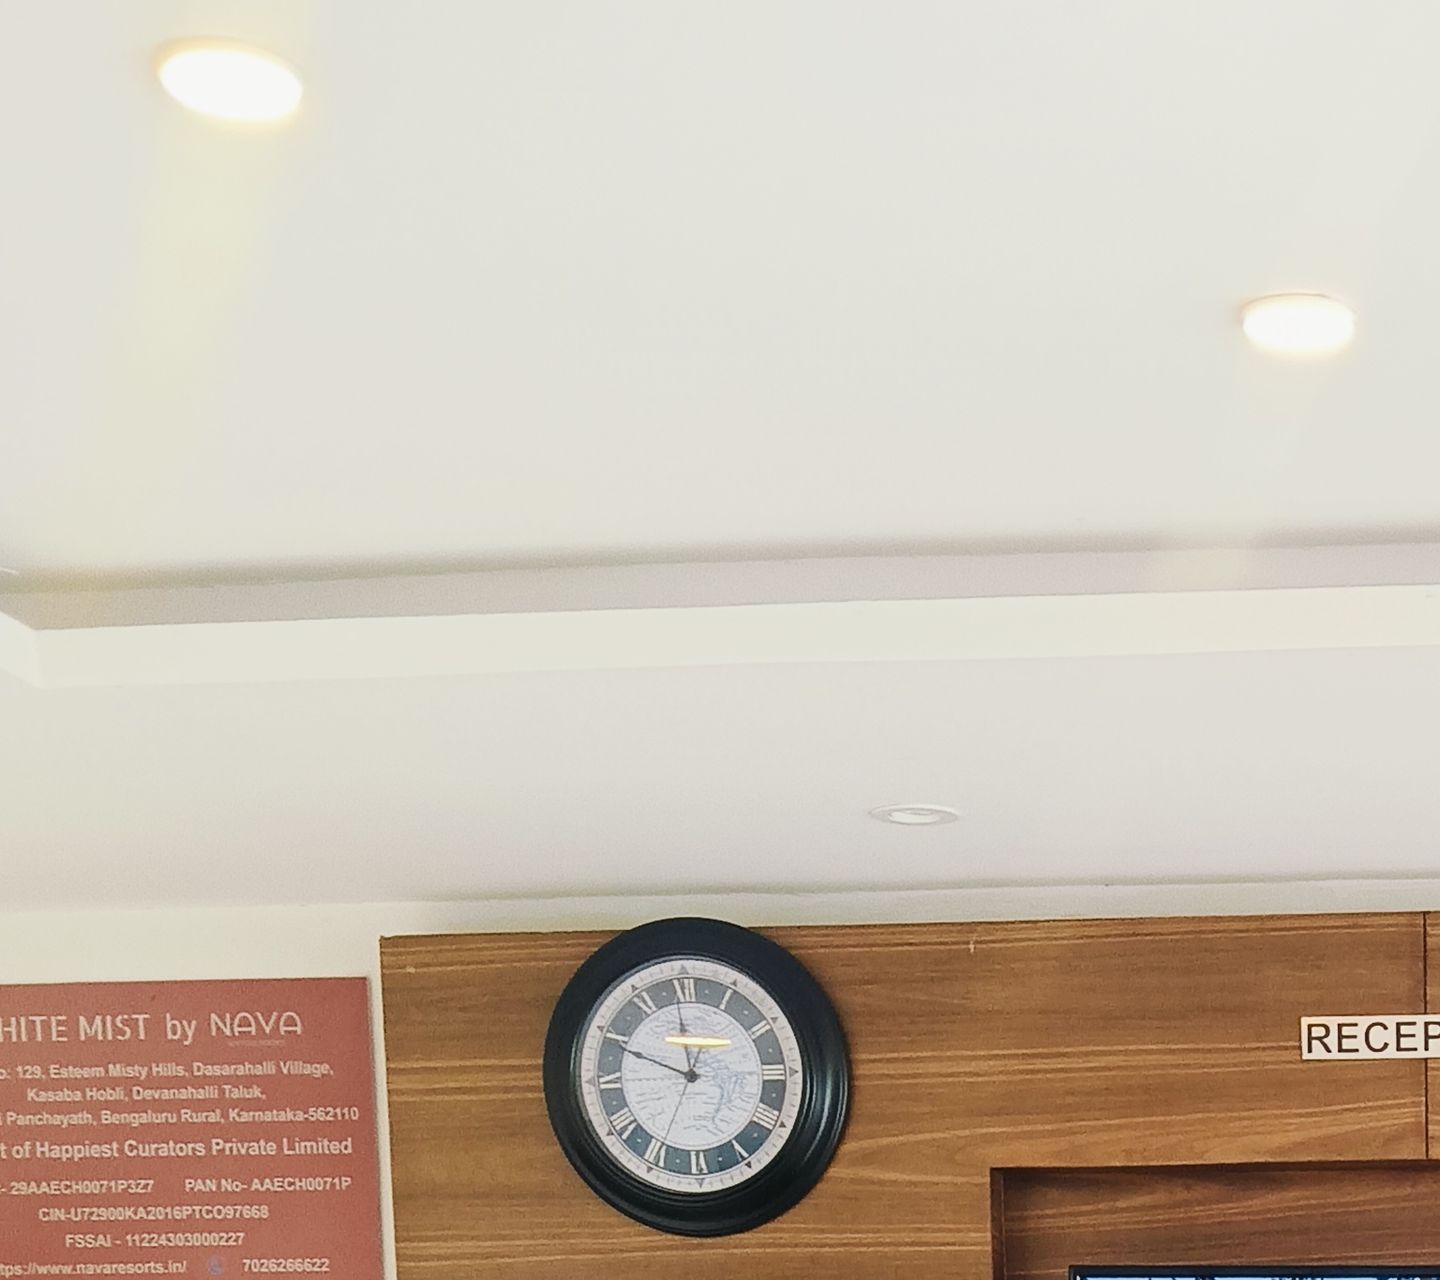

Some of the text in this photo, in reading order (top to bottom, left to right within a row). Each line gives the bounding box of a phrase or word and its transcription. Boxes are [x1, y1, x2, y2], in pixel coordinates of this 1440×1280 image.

[78, 1013, 151, 1041] MIST
[164, 1011, 197, 1046] by
[209, 1011, 303, 1037] NAVA
[49, 1063, 105, 1079] Esteem
[107, 1062, 149, 1080] Misty
[193, 1060, 276, 1077] Dasarahalli
[26, 1086, 82, 1102] Kasaba
[131, 1084, 219, 1100] Devanahalli
[100, 1109, 177, 1127] Bengaluru
[228, 1106, 359, 1123] Karnataka-562110
[11, 1141, 32, 1159] of
[36, 1140, 119, 1161] Happiest
[124, 1139, 206, 1158] Curators
[211, 1137, 277, 1156] Private
[282, 1136, 353, 1155] Limited
[184, 1178, 217, 1192] PAN
[251, 1176, 352, 1192] AAECH0071P
[65, 1234, 112, 1249] FSSAI
